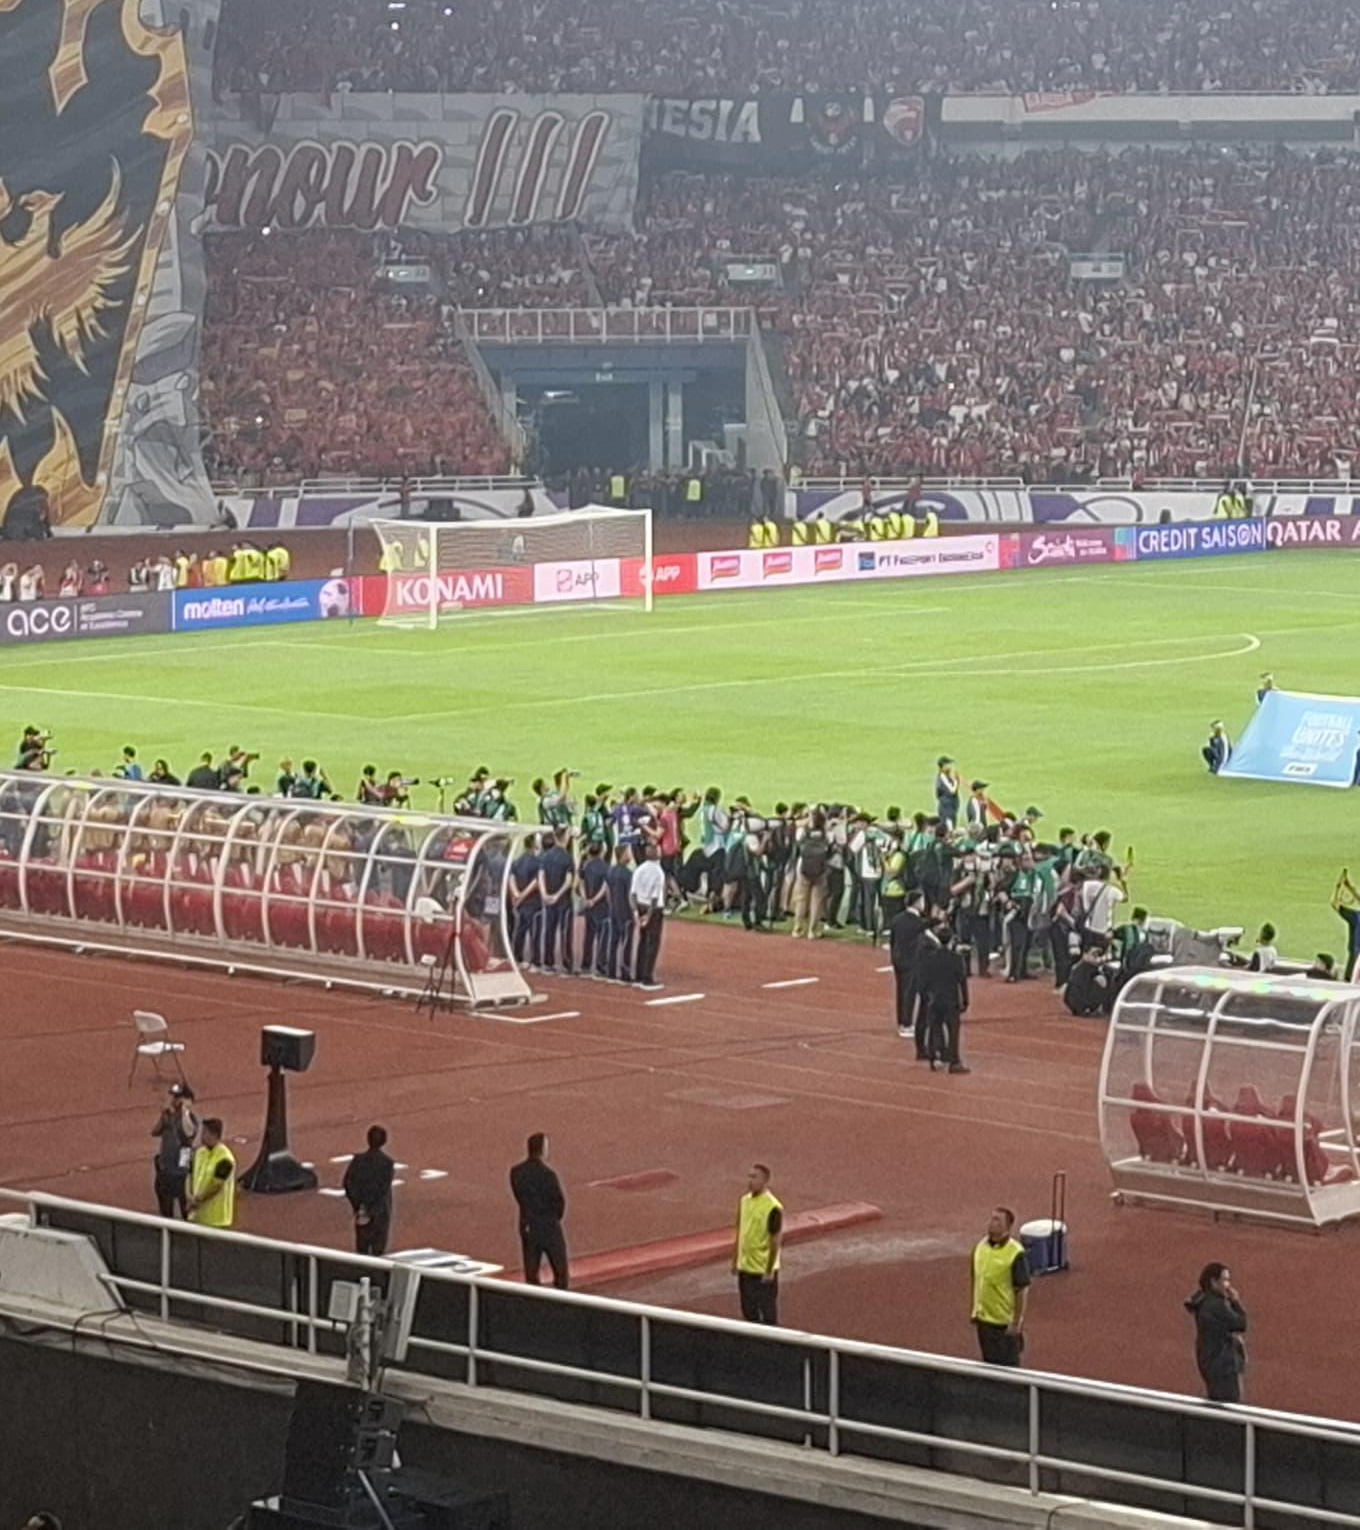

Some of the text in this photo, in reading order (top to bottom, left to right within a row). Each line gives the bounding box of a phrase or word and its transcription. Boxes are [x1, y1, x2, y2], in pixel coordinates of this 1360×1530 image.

[1139, 523, 1262, 552] CREDIT SAISON
[1267, 520, 1341, 547] QATAR
[654, 566, 680, 582] APP
[397, 573, 503, 607] KONAMI
[7, 606, 71, 636] ace
[183, 598, 245, 620] molten
